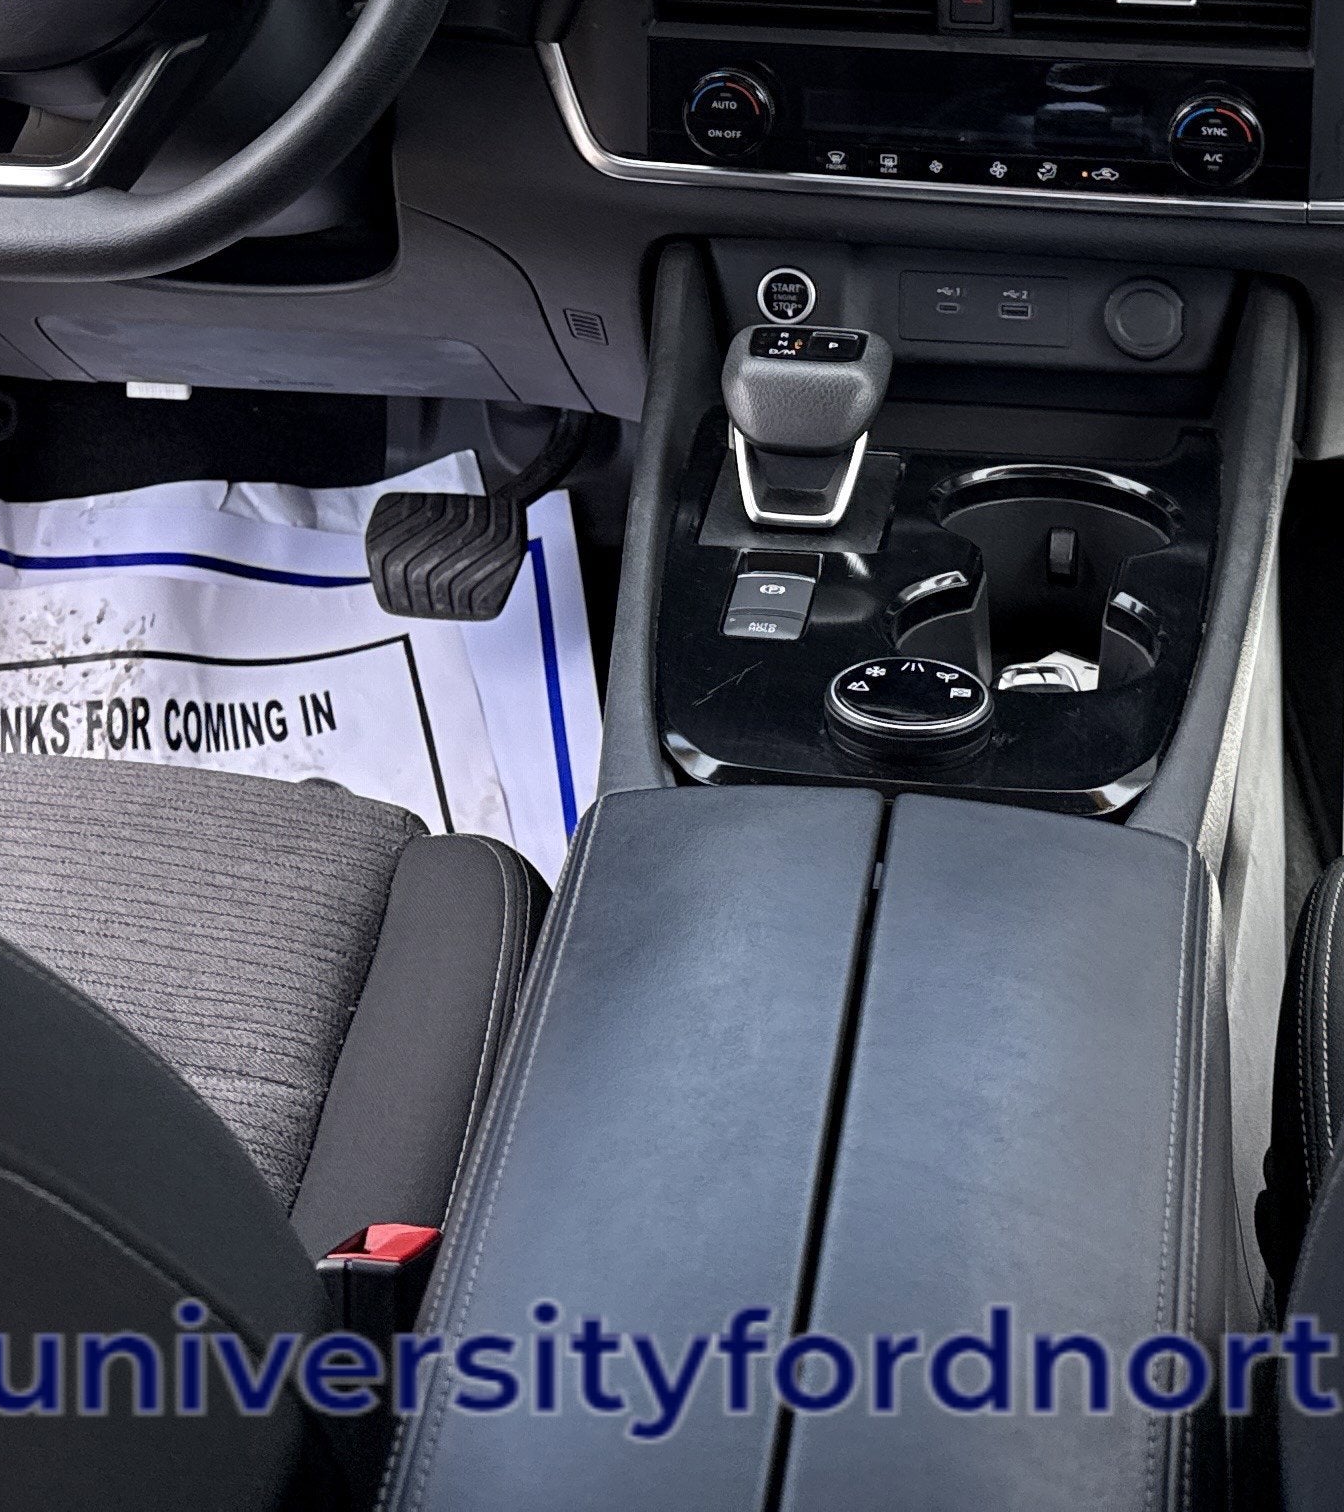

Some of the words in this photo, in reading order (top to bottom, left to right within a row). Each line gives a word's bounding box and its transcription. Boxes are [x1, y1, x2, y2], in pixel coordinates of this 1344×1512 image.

[710, 100, 738, 110] AUTO
[1200, 126, 1228, 137] SYNC
[1203, 153, 1224, 163] A/C
[771, 282, 800, 293] START
[86, 696, 152, 753] FOR
[163, 697, 289, 754] COMING
[299, 690, 338, 737] IN
